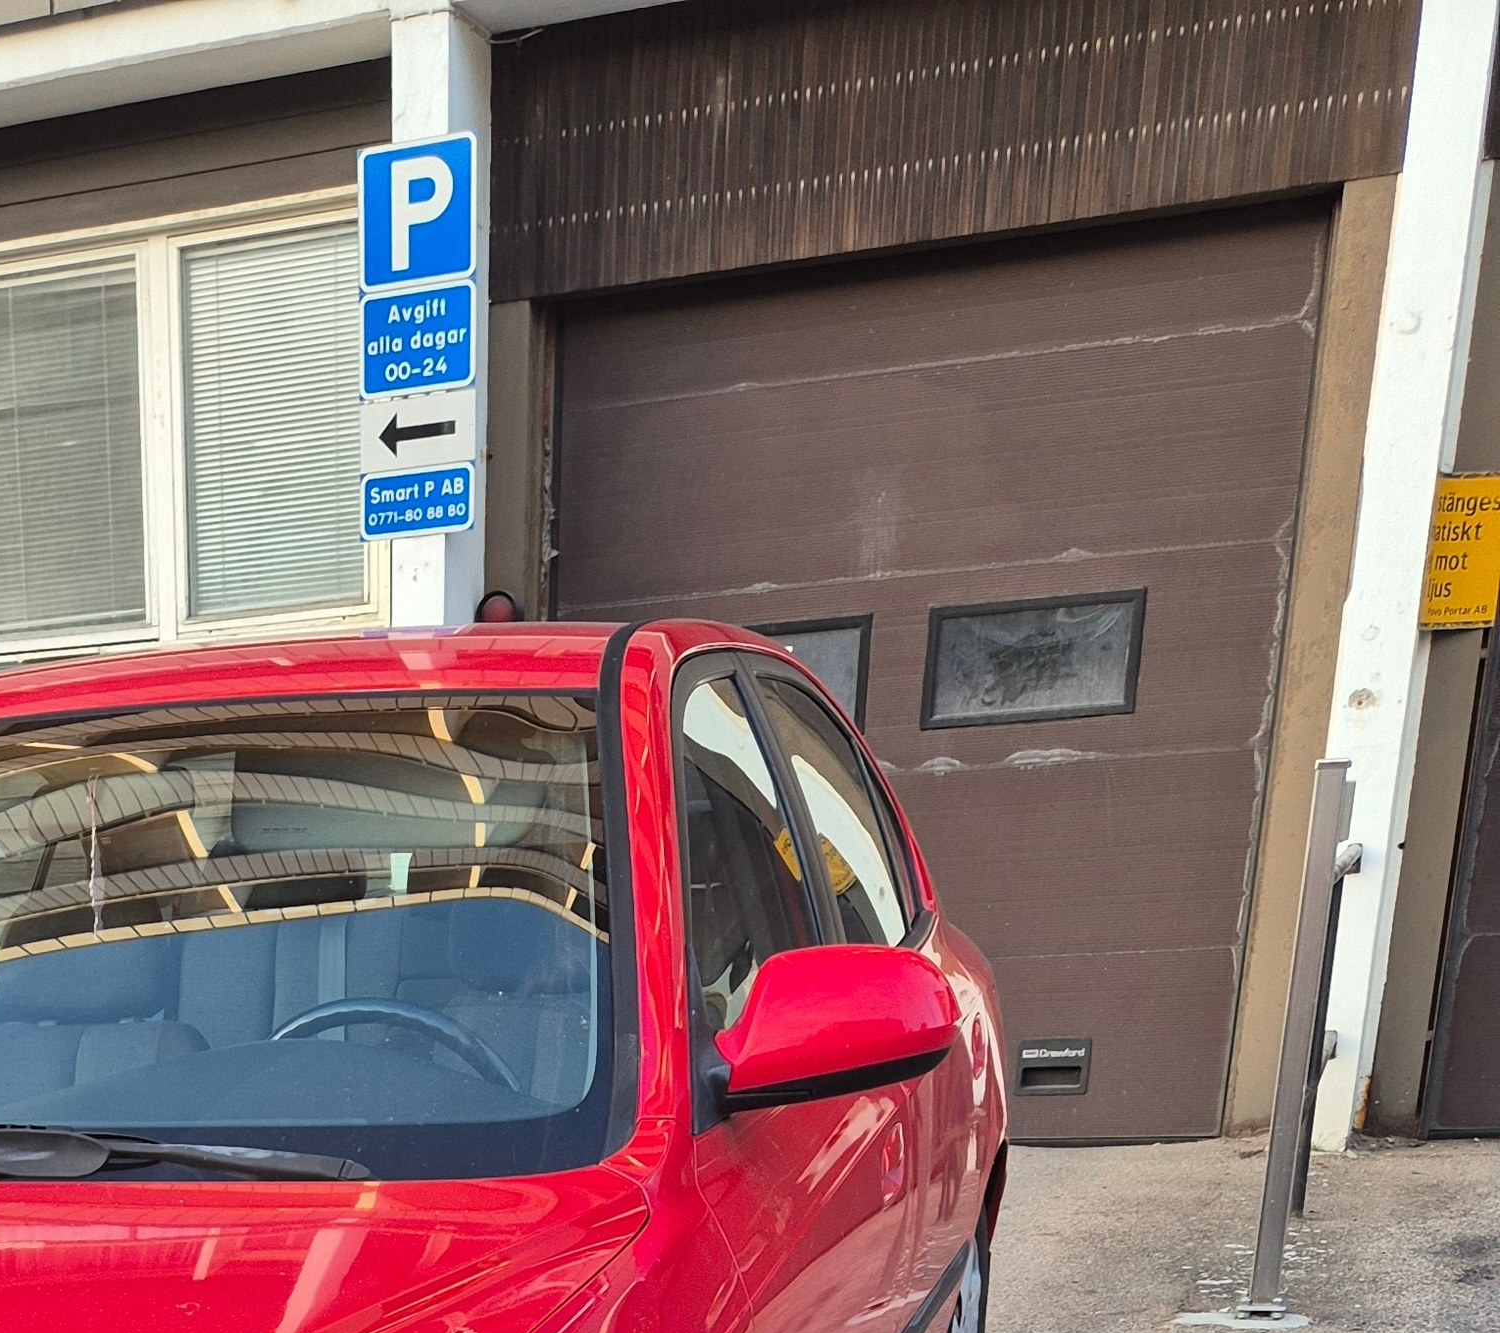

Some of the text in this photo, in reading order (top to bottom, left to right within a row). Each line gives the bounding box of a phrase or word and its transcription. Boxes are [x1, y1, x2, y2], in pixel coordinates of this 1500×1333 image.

[391, 156, 453, 272] P
[387, 297, 446, 324] Avgift
[367, 327, 467, 356] alla dagar
[385, 356, 447, 382] 00-24
[370, 477, 465, 504] Smart P AB
[368, 502, 466, 527] 0771-80 88 80
[1432, 521, 1483, 542] atiskt
[1434, 551, 1469, 571] mot
[1426, 578, 1452, 603] ljus
[1444, 606, 1471, 616] Portar
[1474, 604, 1488, 614] AB
[1039, 1047, 1086, 1058] Crawford
